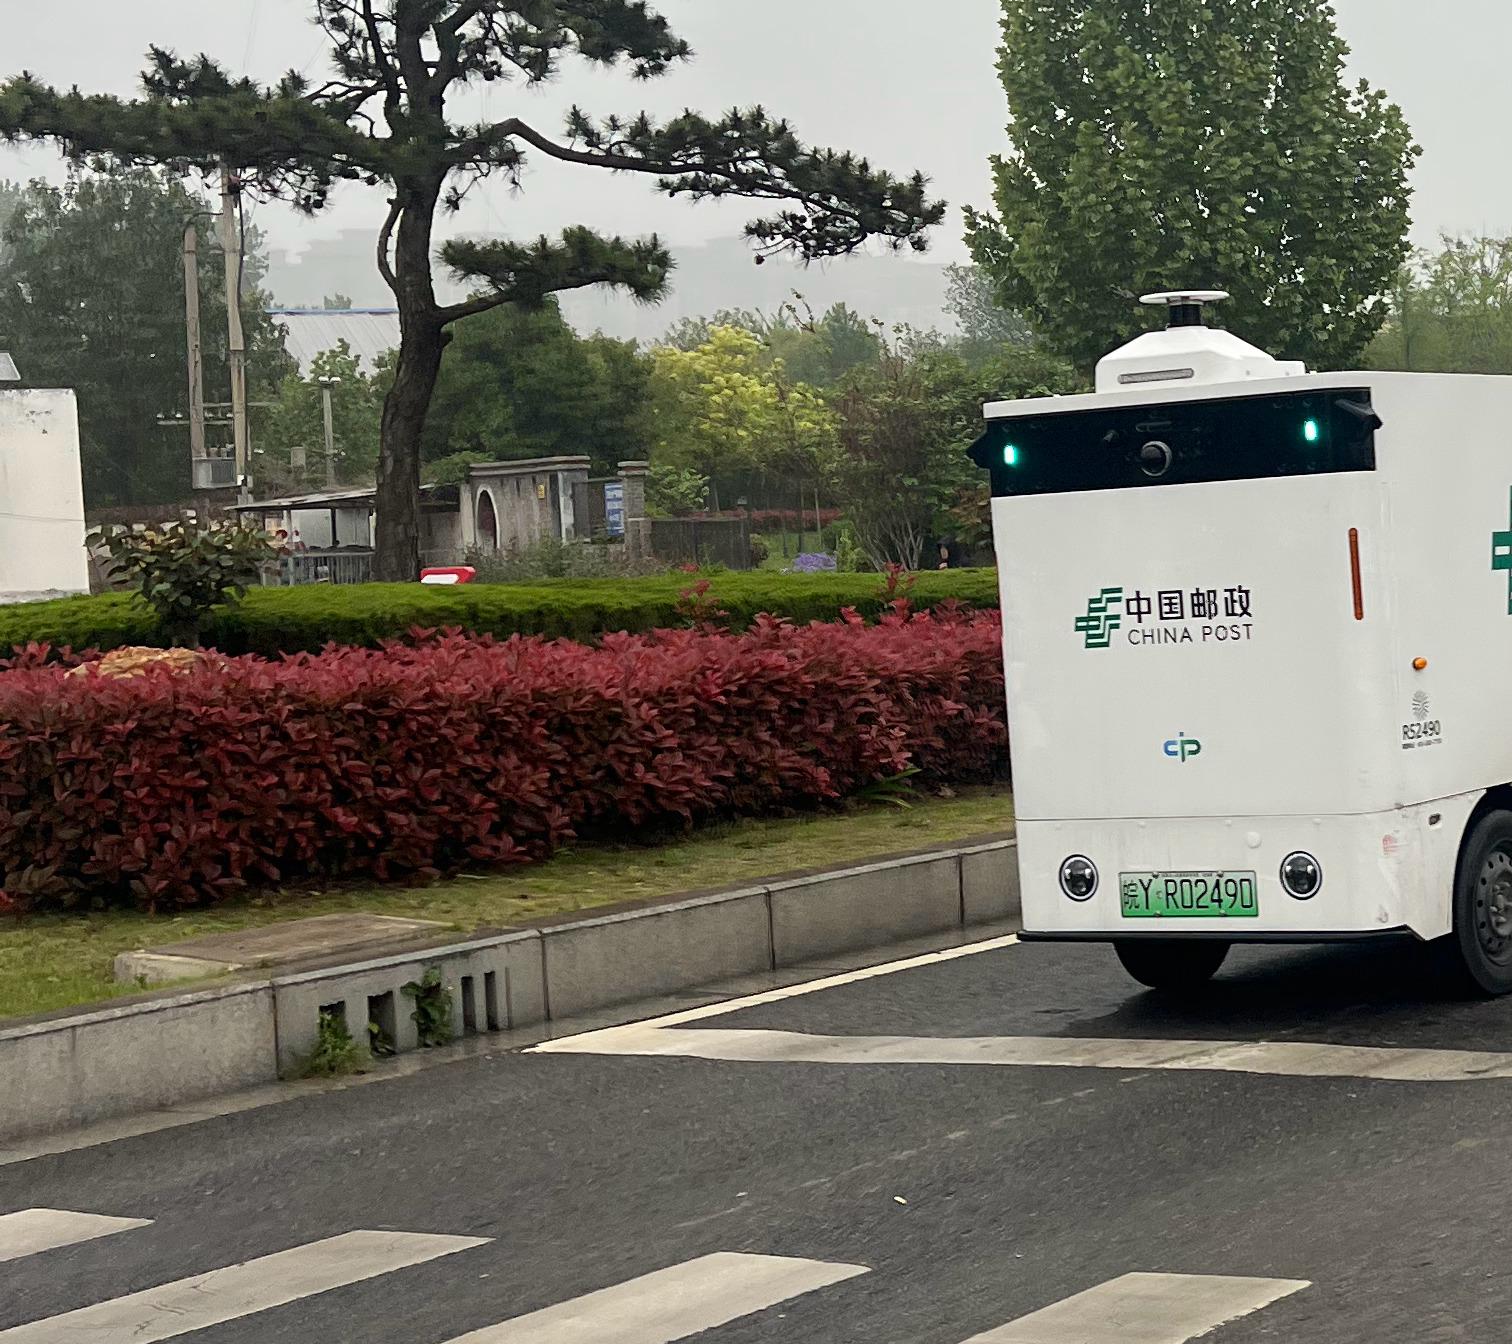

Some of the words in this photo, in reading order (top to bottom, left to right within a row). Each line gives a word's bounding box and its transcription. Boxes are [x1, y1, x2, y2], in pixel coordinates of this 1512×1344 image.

[1126, 585, 1252, 623] 中国邮政
[1128, 626, 1193, 645] CHINA
[1202, 624, 1253, 642] POST
